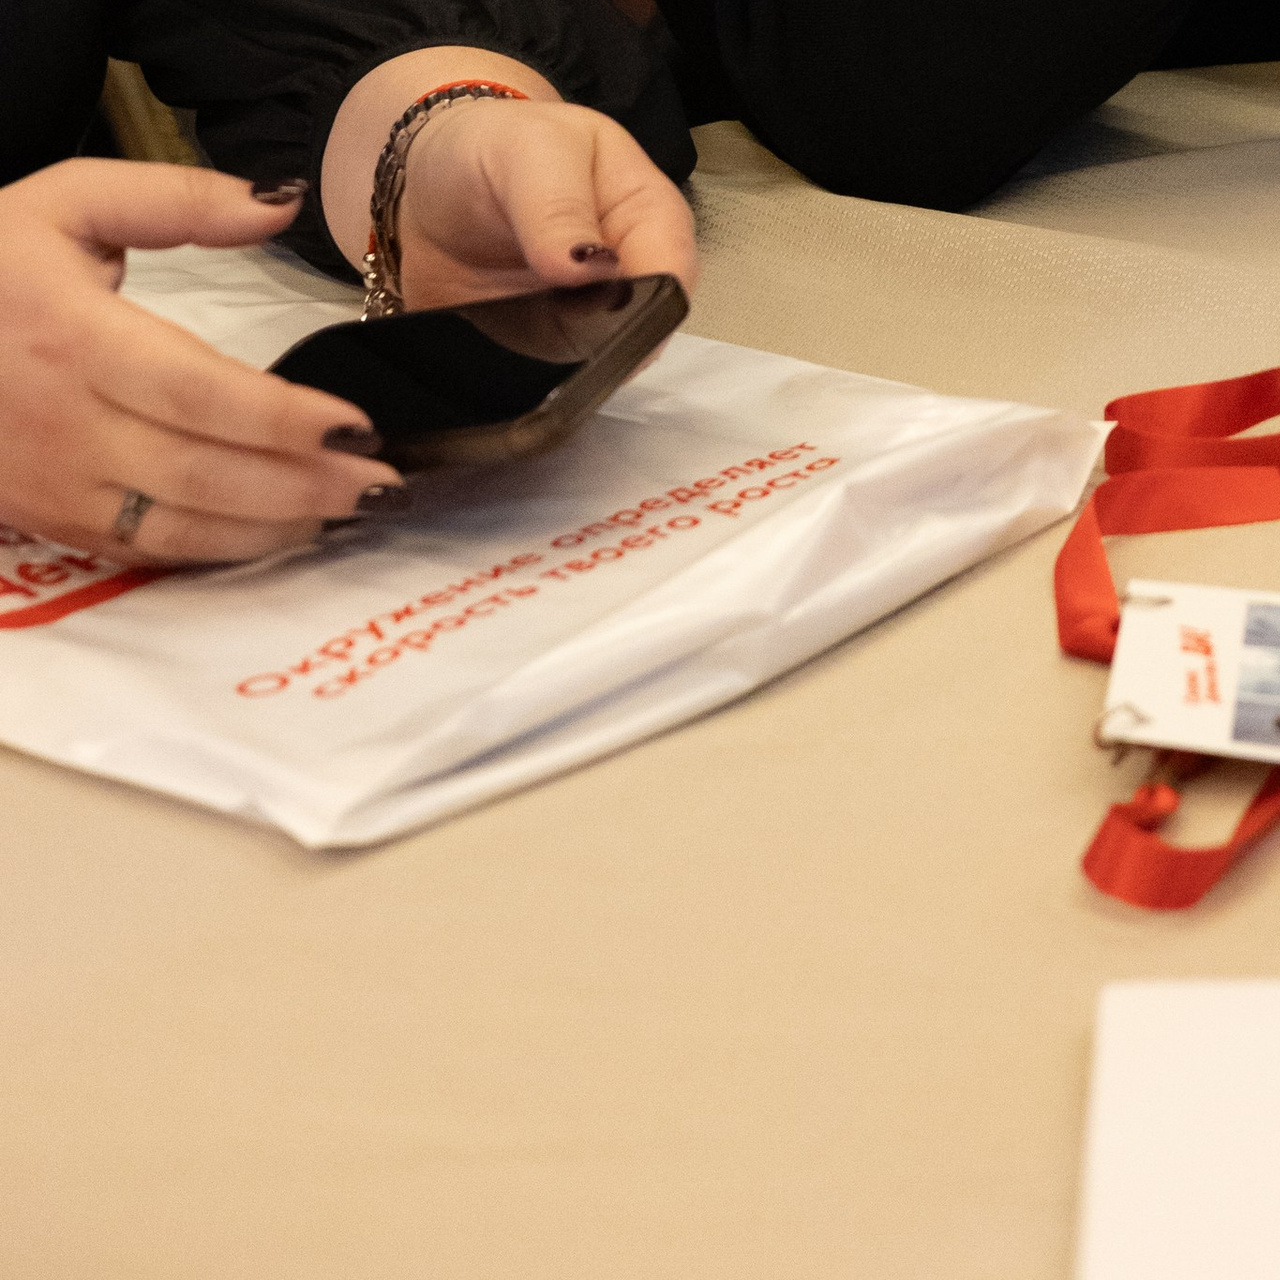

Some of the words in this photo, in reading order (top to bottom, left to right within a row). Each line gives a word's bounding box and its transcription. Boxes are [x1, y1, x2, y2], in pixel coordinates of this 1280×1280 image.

[234, 552, 545, 699] Окружение
[550, 441, 818, 550] определяет
[311, 584, 540, 700] скорость
[539, 515, 702, 581] твоего
[705, 456, 841, 519] роста
